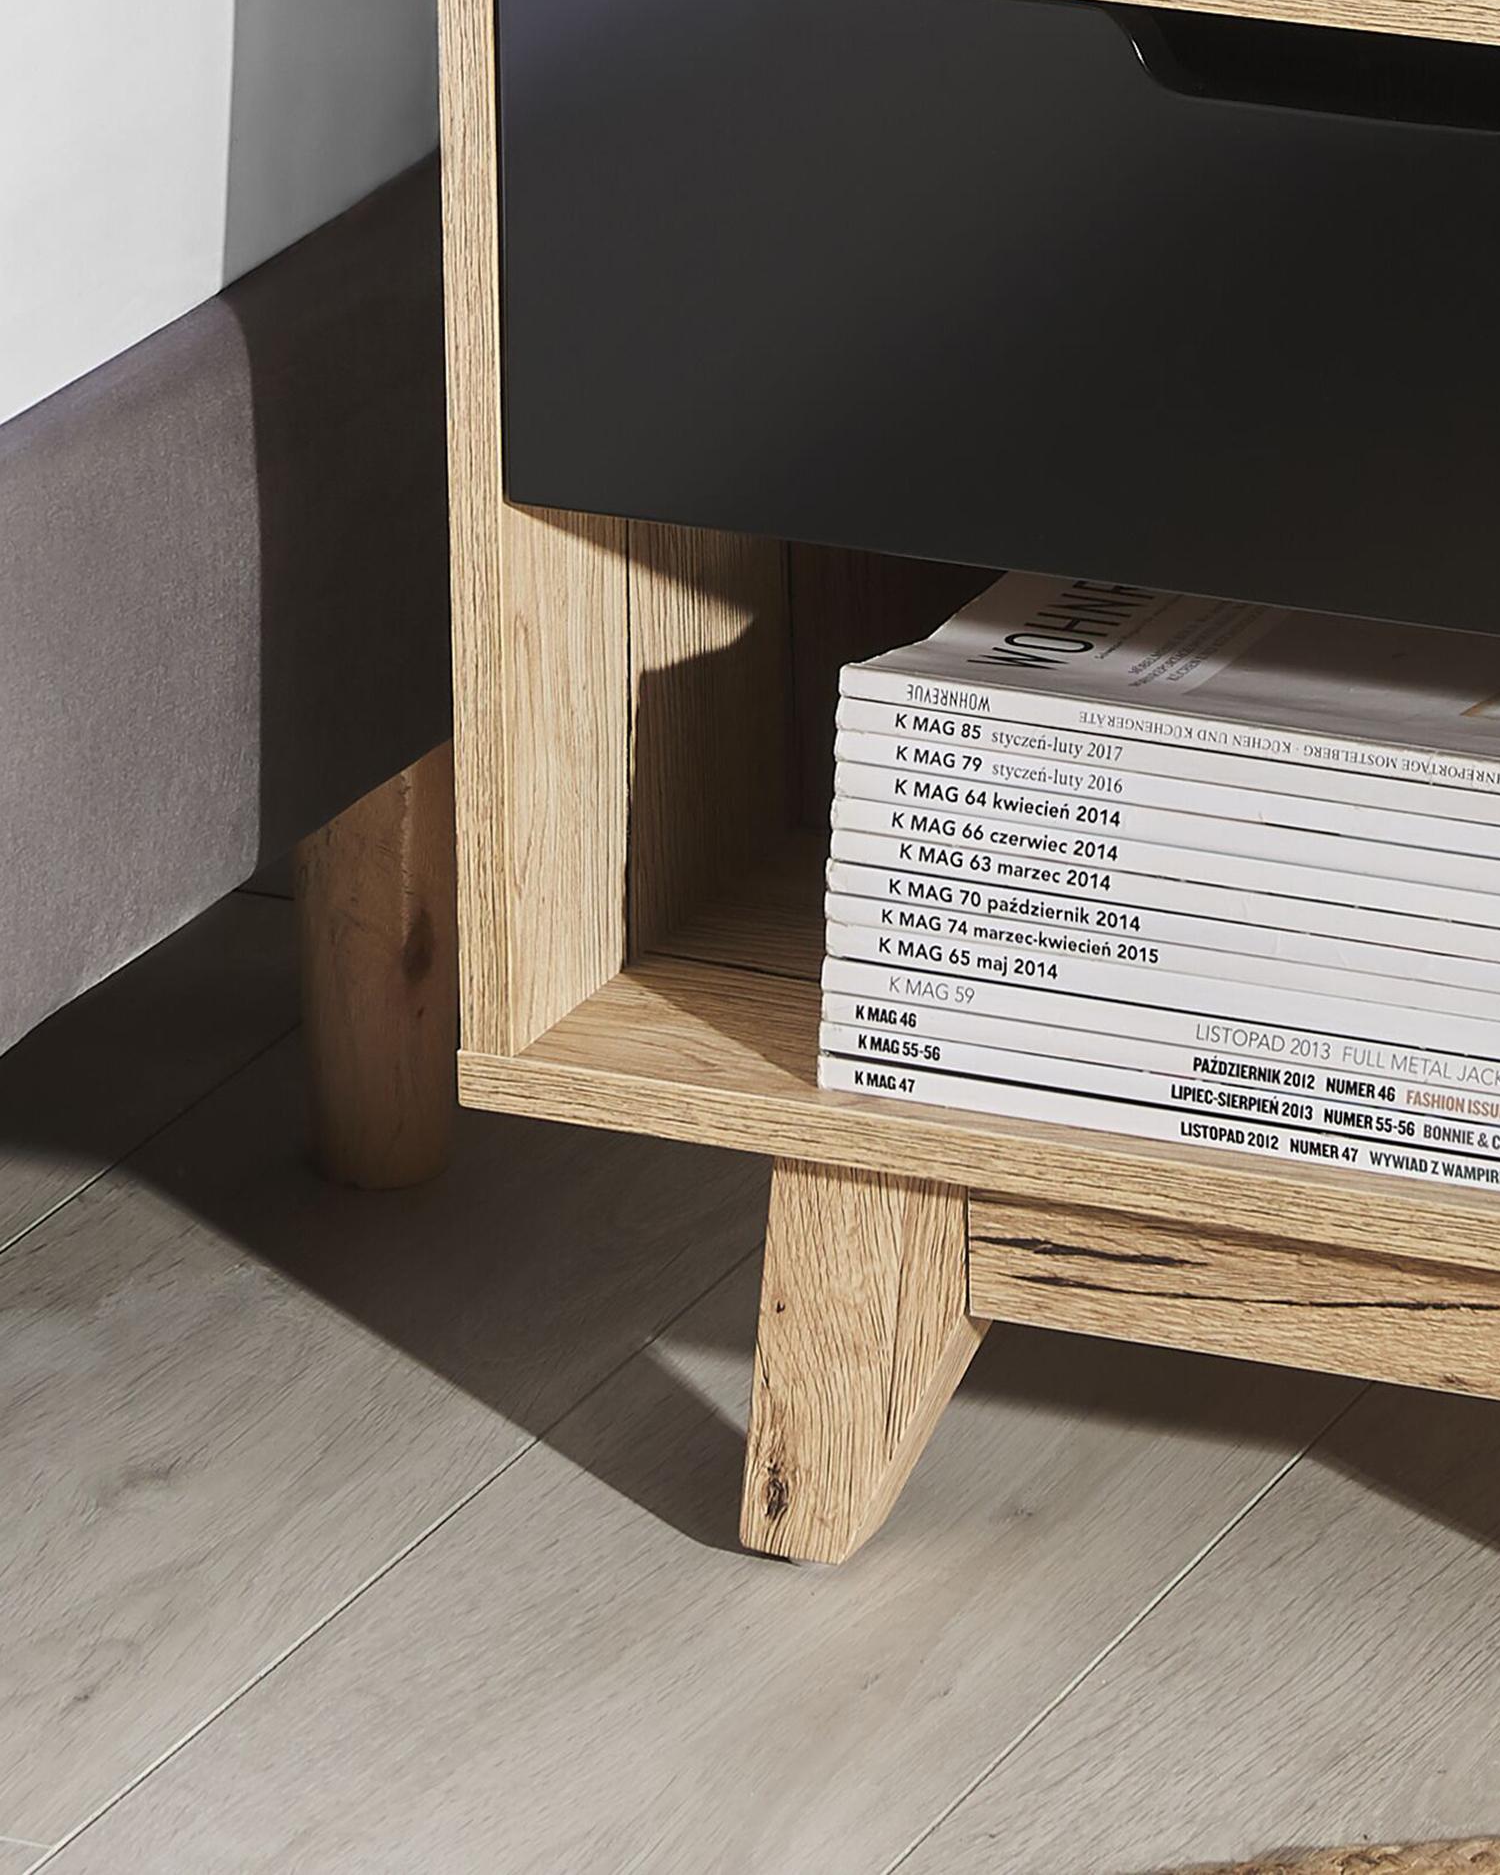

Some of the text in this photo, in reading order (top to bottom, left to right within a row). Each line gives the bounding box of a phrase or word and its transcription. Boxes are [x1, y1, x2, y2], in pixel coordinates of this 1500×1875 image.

[907, 683, 991, 713] WOHNREVUE
[895, 713, 1124, 762] K MAG 85 styczeń-luty 2017
[1196, 727, 1228, 745] UND
[1232, 731, 1292, 754] KÜCHEN
[1303, 743, 1399, 770] MOSTELBERG
[896, 746, 1123, 794] K MAG 79 styczeń-luty 2016
[894, 778, 1121, 827] K MAG 64 kwiecień 2014
[891, 812, 1118, 862] K MAG 66 czerwiec 2014
[900, 843, 1111, 891] K MAG 63 marzec 2014
[889, 878, 1141, 932] K MAG 70 październik 2014
[879, 937, 1059, 980] K MAG 65 maj 2014
[881, 908, 1159, 964] K MAG 74 marzec-kwiecień 2015
[889, 976, 976, 1005] K MAG 59
[855, 1004, 917, 1028] K MAG 46
[858, 1034, 941, 1062] K MAG 55-56
[1196, 1023, 1285, 1053] LISTOPAD
[1290, 1037, 1331, 1060] 2013
[1342, 1045, 1386, 1069] FULL
[1391, 1053, 1452, 1080] METAL
[854, 1070, 916, 1094] K MAG 47
[1193, 1055, 1281, 1085] PAŹDZIERNIK
[1283, 1070, 1315, 1090] 2012
[1326, 1076, 1376, 1099] NUMER
[1377, 1085, 1396, 1102] 46
[1406, 1089, 1465, 1113] FASHION
[1171, 1084, 1279, 1116] LIPIEC-SIERPIEŃ
[1281, 1101, 1313, 1121] 2013
[1324, 1108, 1373, 1130] NUMER
[1375, 1116, 1415, 1137] 55-56
[1423, 1123, 1474, 1146] BONNIE
[1477, 1132, 1489, 1149] &
[1180, 1121, 1245, 1144] LISTOPAD
[1247, 1131, 1279, 1150] 2012
[1290, 1137, 1339, 1160] NUMER
[1341, 1145, 1359, 1162] 47
[1369, 1150, 1428, 1173] WYWIAD
[1430, 1159, 1440, 1176] Z
